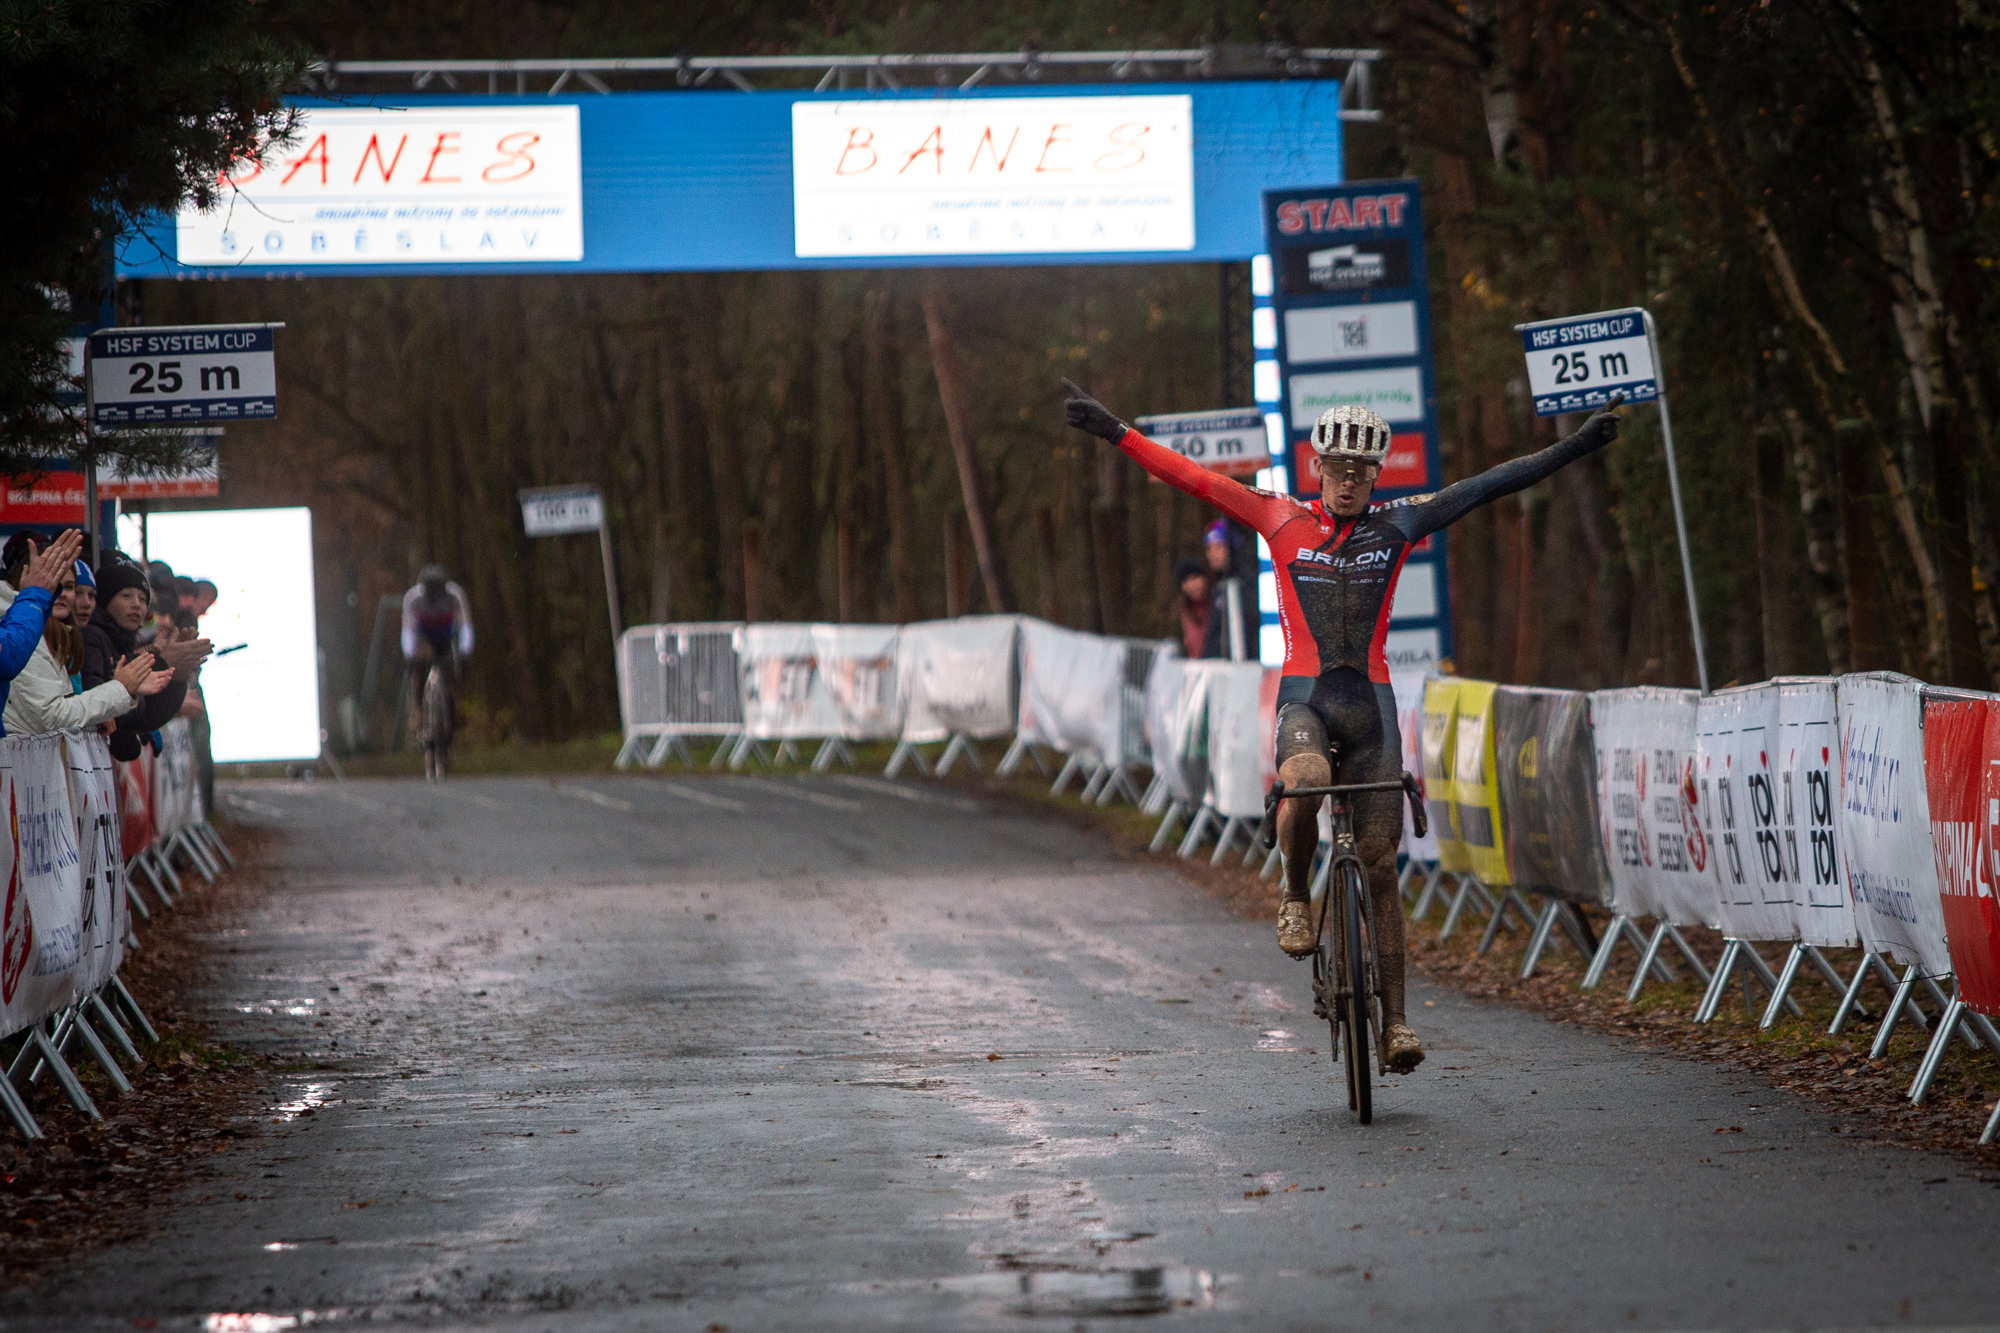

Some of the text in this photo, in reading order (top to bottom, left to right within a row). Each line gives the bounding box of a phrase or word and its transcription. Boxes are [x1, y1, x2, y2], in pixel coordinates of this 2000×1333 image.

[836, 123, 1150, 176] BANES
[1277, 193, 1408, 235] START
[107, 332, 257, 354] HSF SYSTEM CUP
[1532, 317, 1634, 347] HSF SYSTEM CUP
[129, 361, 241, 394] 25 m
[1551, 350, 1629, 385] 25 m
[1216, 438, 1242, 455] m
[1295, 560, 1336, 573] RACING
[1296, 548, 1391, 568] BRILON
[1748, 773, 1777, 827] TOI
[1806, 769, 1832, 827] TOI
[1756, 829, 1788, 883] TOI
[1810, 829, 1838, 885] TOI
